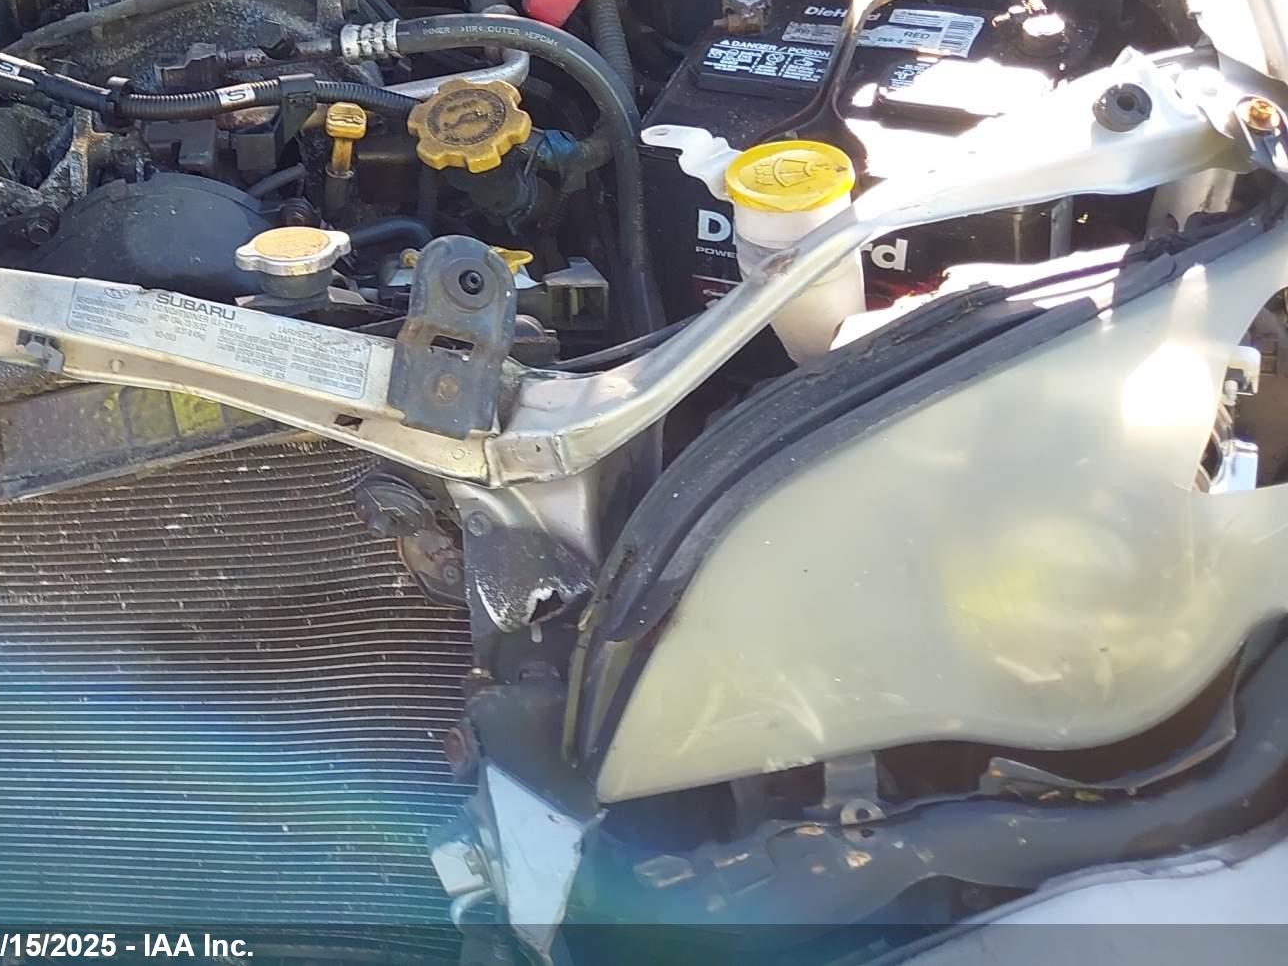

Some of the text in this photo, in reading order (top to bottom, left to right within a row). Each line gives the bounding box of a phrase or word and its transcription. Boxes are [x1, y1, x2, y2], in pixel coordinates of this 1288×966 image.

[804, 6, 881, 21] DieHd
[487, 25, 520, 35] OUTER
[731, 40, 778, 51] DANGER
[788, 46, 831, 58] POISON
[227, 89, 246, 101] S
[695, 246, 737, 259] POWE
[156, 292, 236, 320] SUBARU
